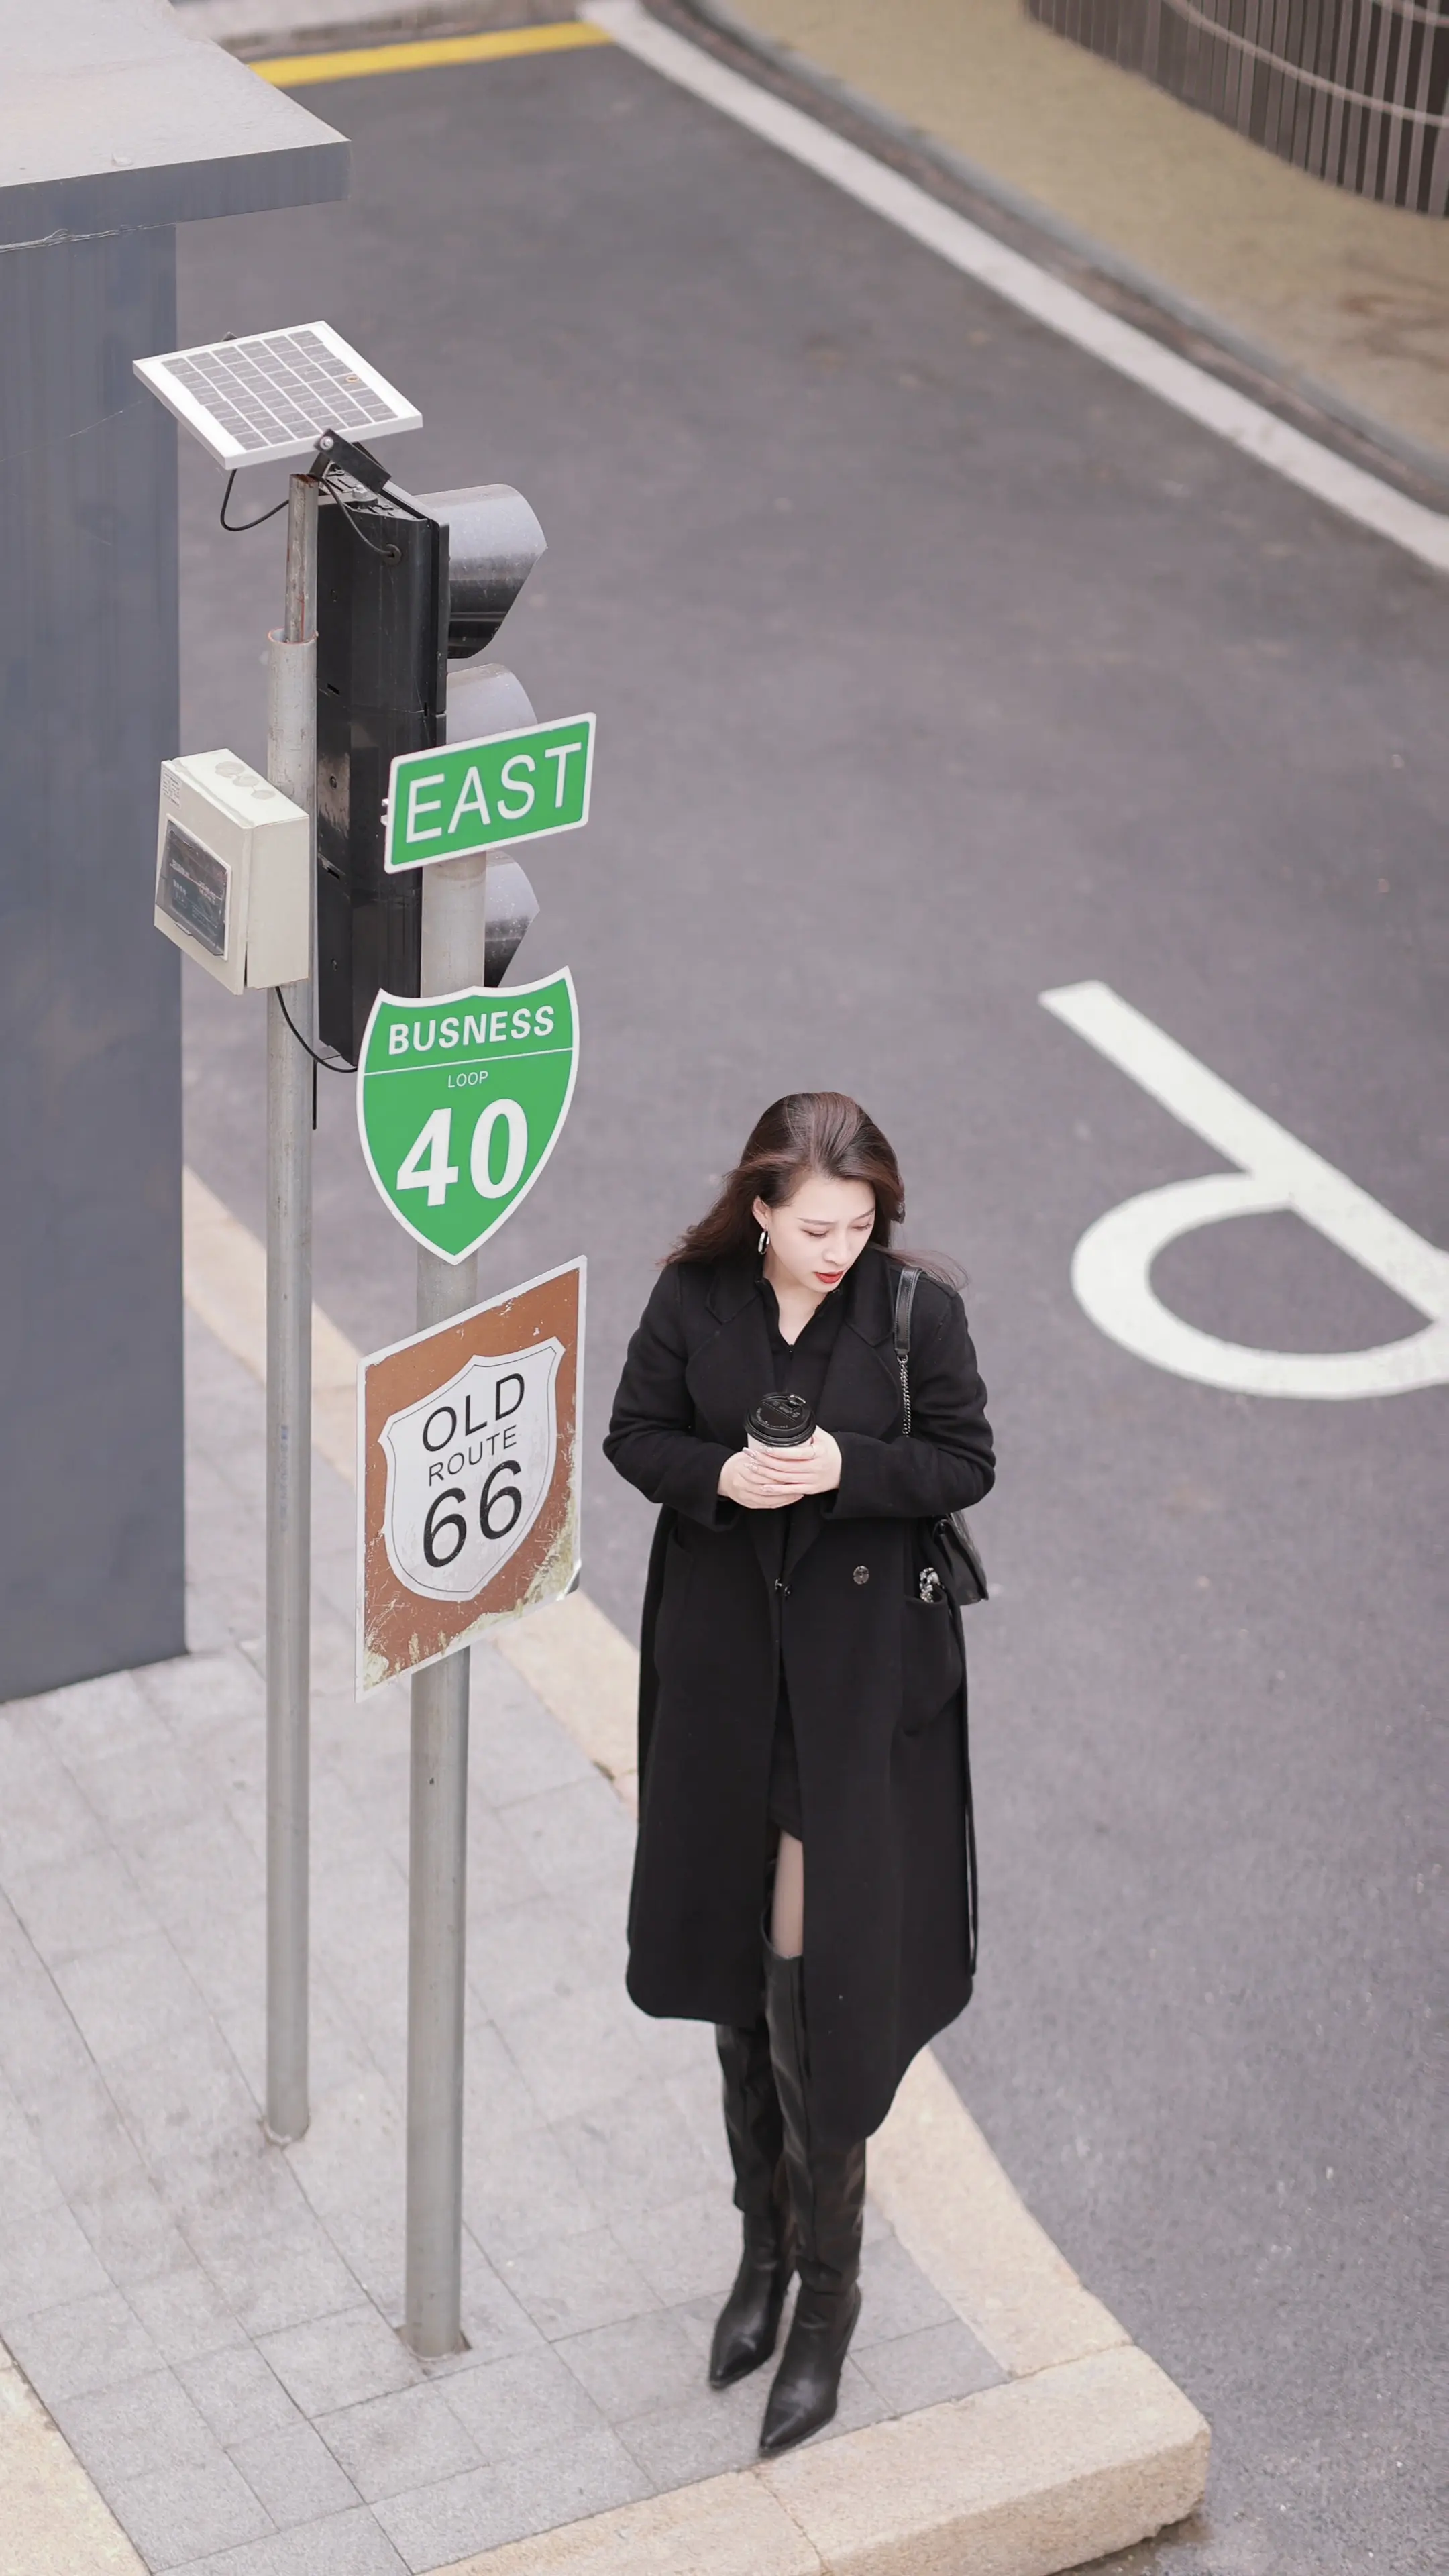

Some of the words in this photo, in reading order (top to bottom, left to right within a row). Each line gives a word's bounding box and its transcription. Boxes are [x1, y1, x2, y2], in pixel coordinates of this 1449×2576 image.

[405, 741, 582, 844] EAST
[388, 1004, 555, 1055] BUSNESS
[447, 1070, 489, 1089] LOOP
[396, 1098, 528, 1207] 40
[423, 1373, 525, 1452] OLD
[429, 1424, 517, 1487] ROUTE
[423, 1460, 522, 1568] 66
